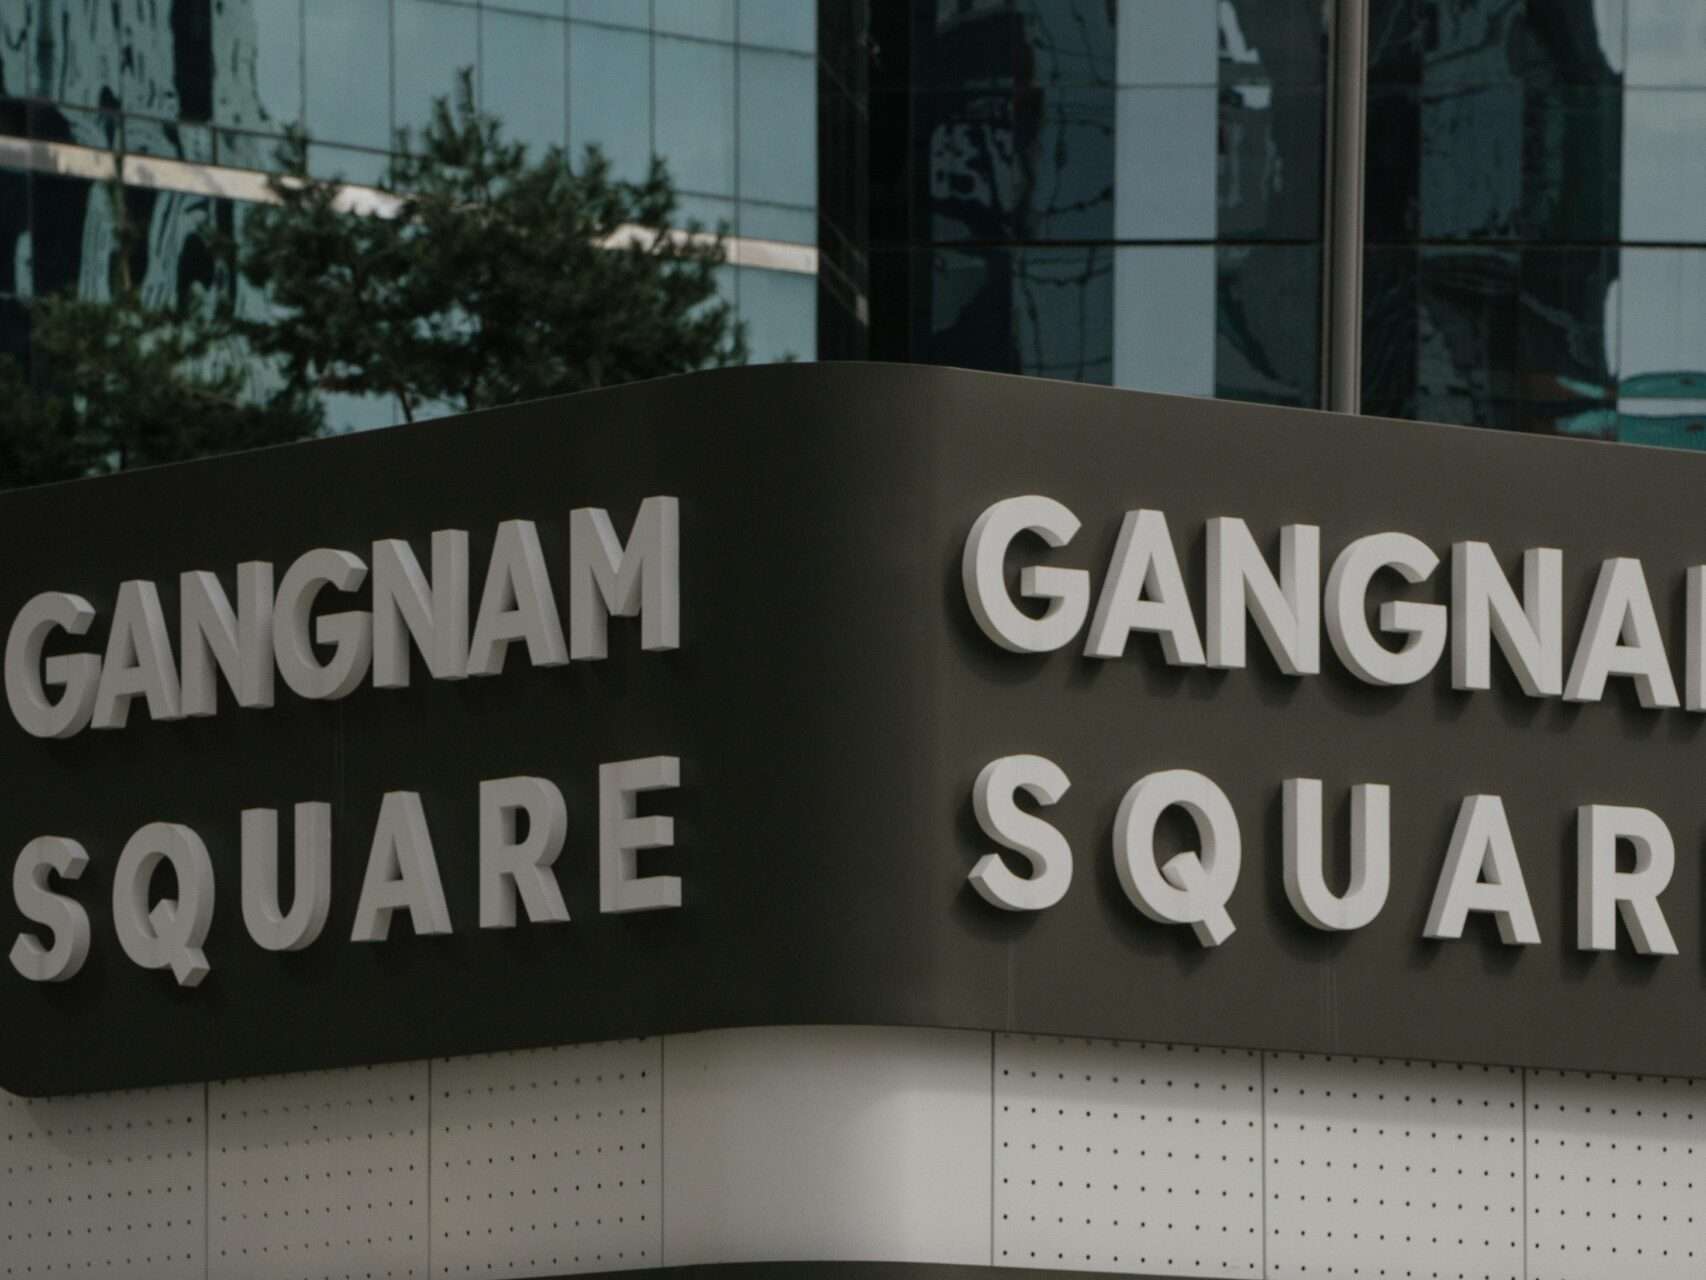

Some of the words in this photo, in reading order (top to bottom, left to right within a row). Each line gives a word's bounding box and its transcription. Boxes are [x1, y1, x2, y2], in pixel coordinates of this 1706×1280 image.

[4, 495, 680, 738] GANGNAM
[962, 494, 1706, 712] GANGNA
[9, 755, 682, 987] SQUARE
